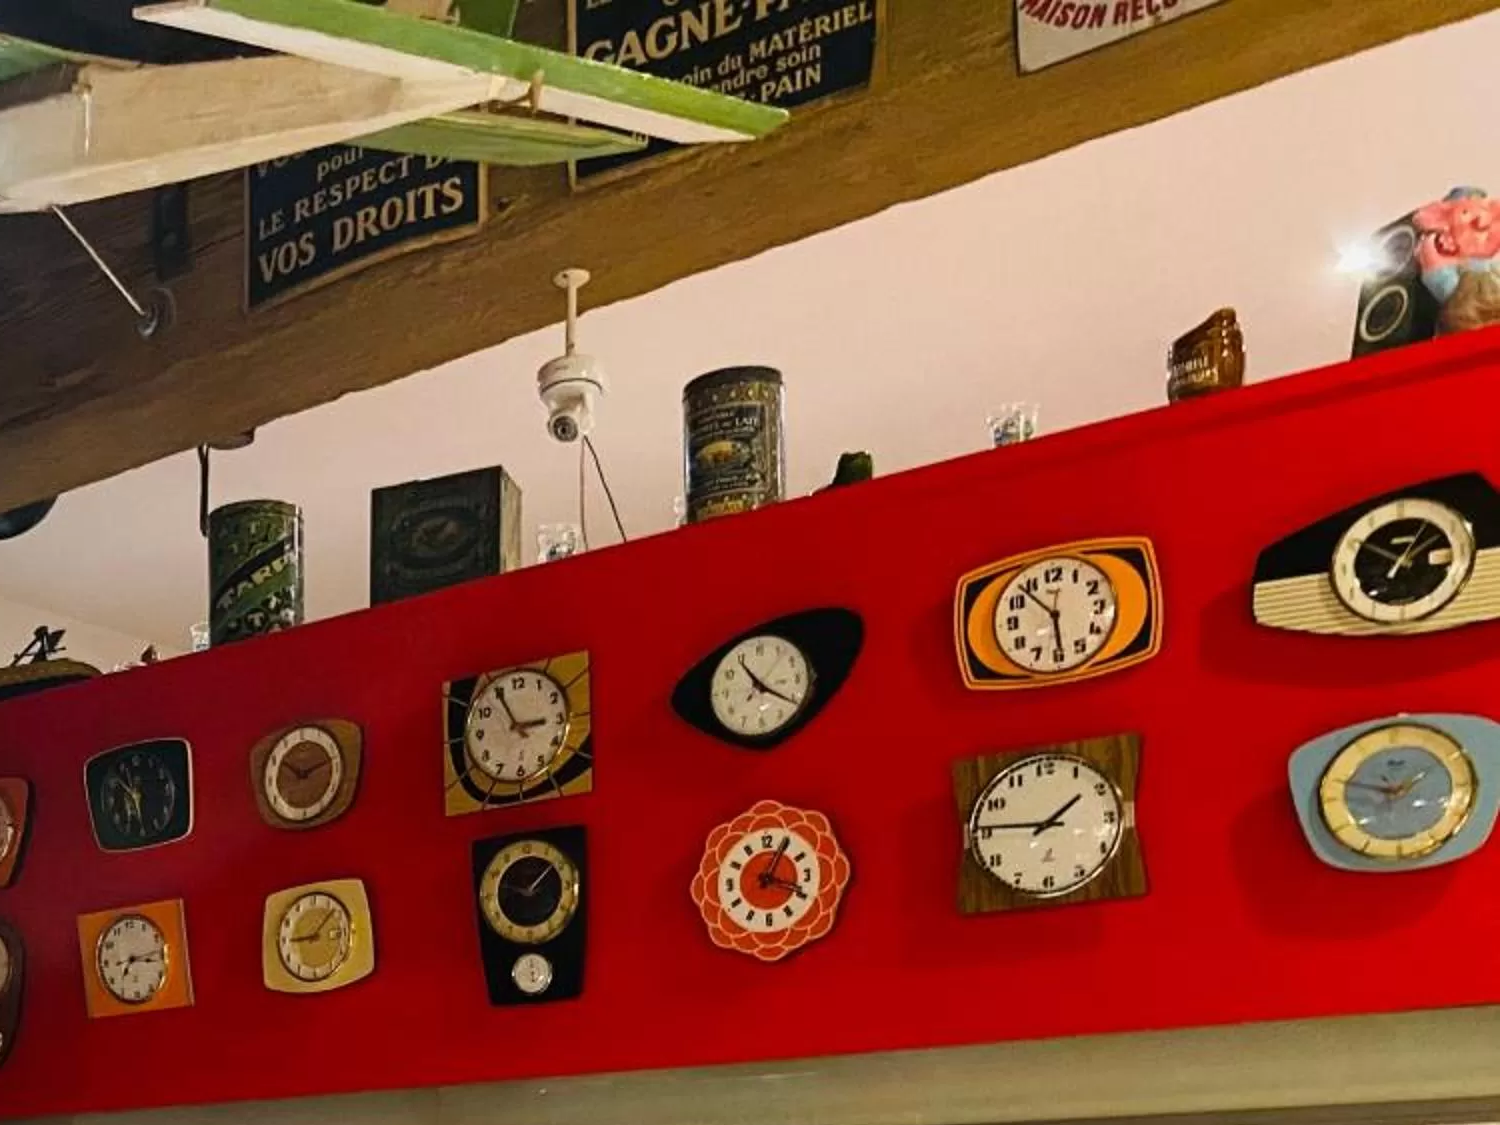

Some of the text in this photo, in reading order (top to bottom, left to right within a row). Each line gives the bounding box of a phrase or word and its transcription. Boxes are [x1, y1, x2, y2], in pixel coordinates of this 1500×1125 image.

[750, 2, 873, 61] MATÉRIEL
[776, 44, 821, 69] soin
[259, 208, 286, 241] LE
[293, 154, 414, 223] RESPECT
[257, 176, 465, 284] VOS DROITS
[1044, 568, 1063, 583] 12
[511, 678, 524, 690] 12
